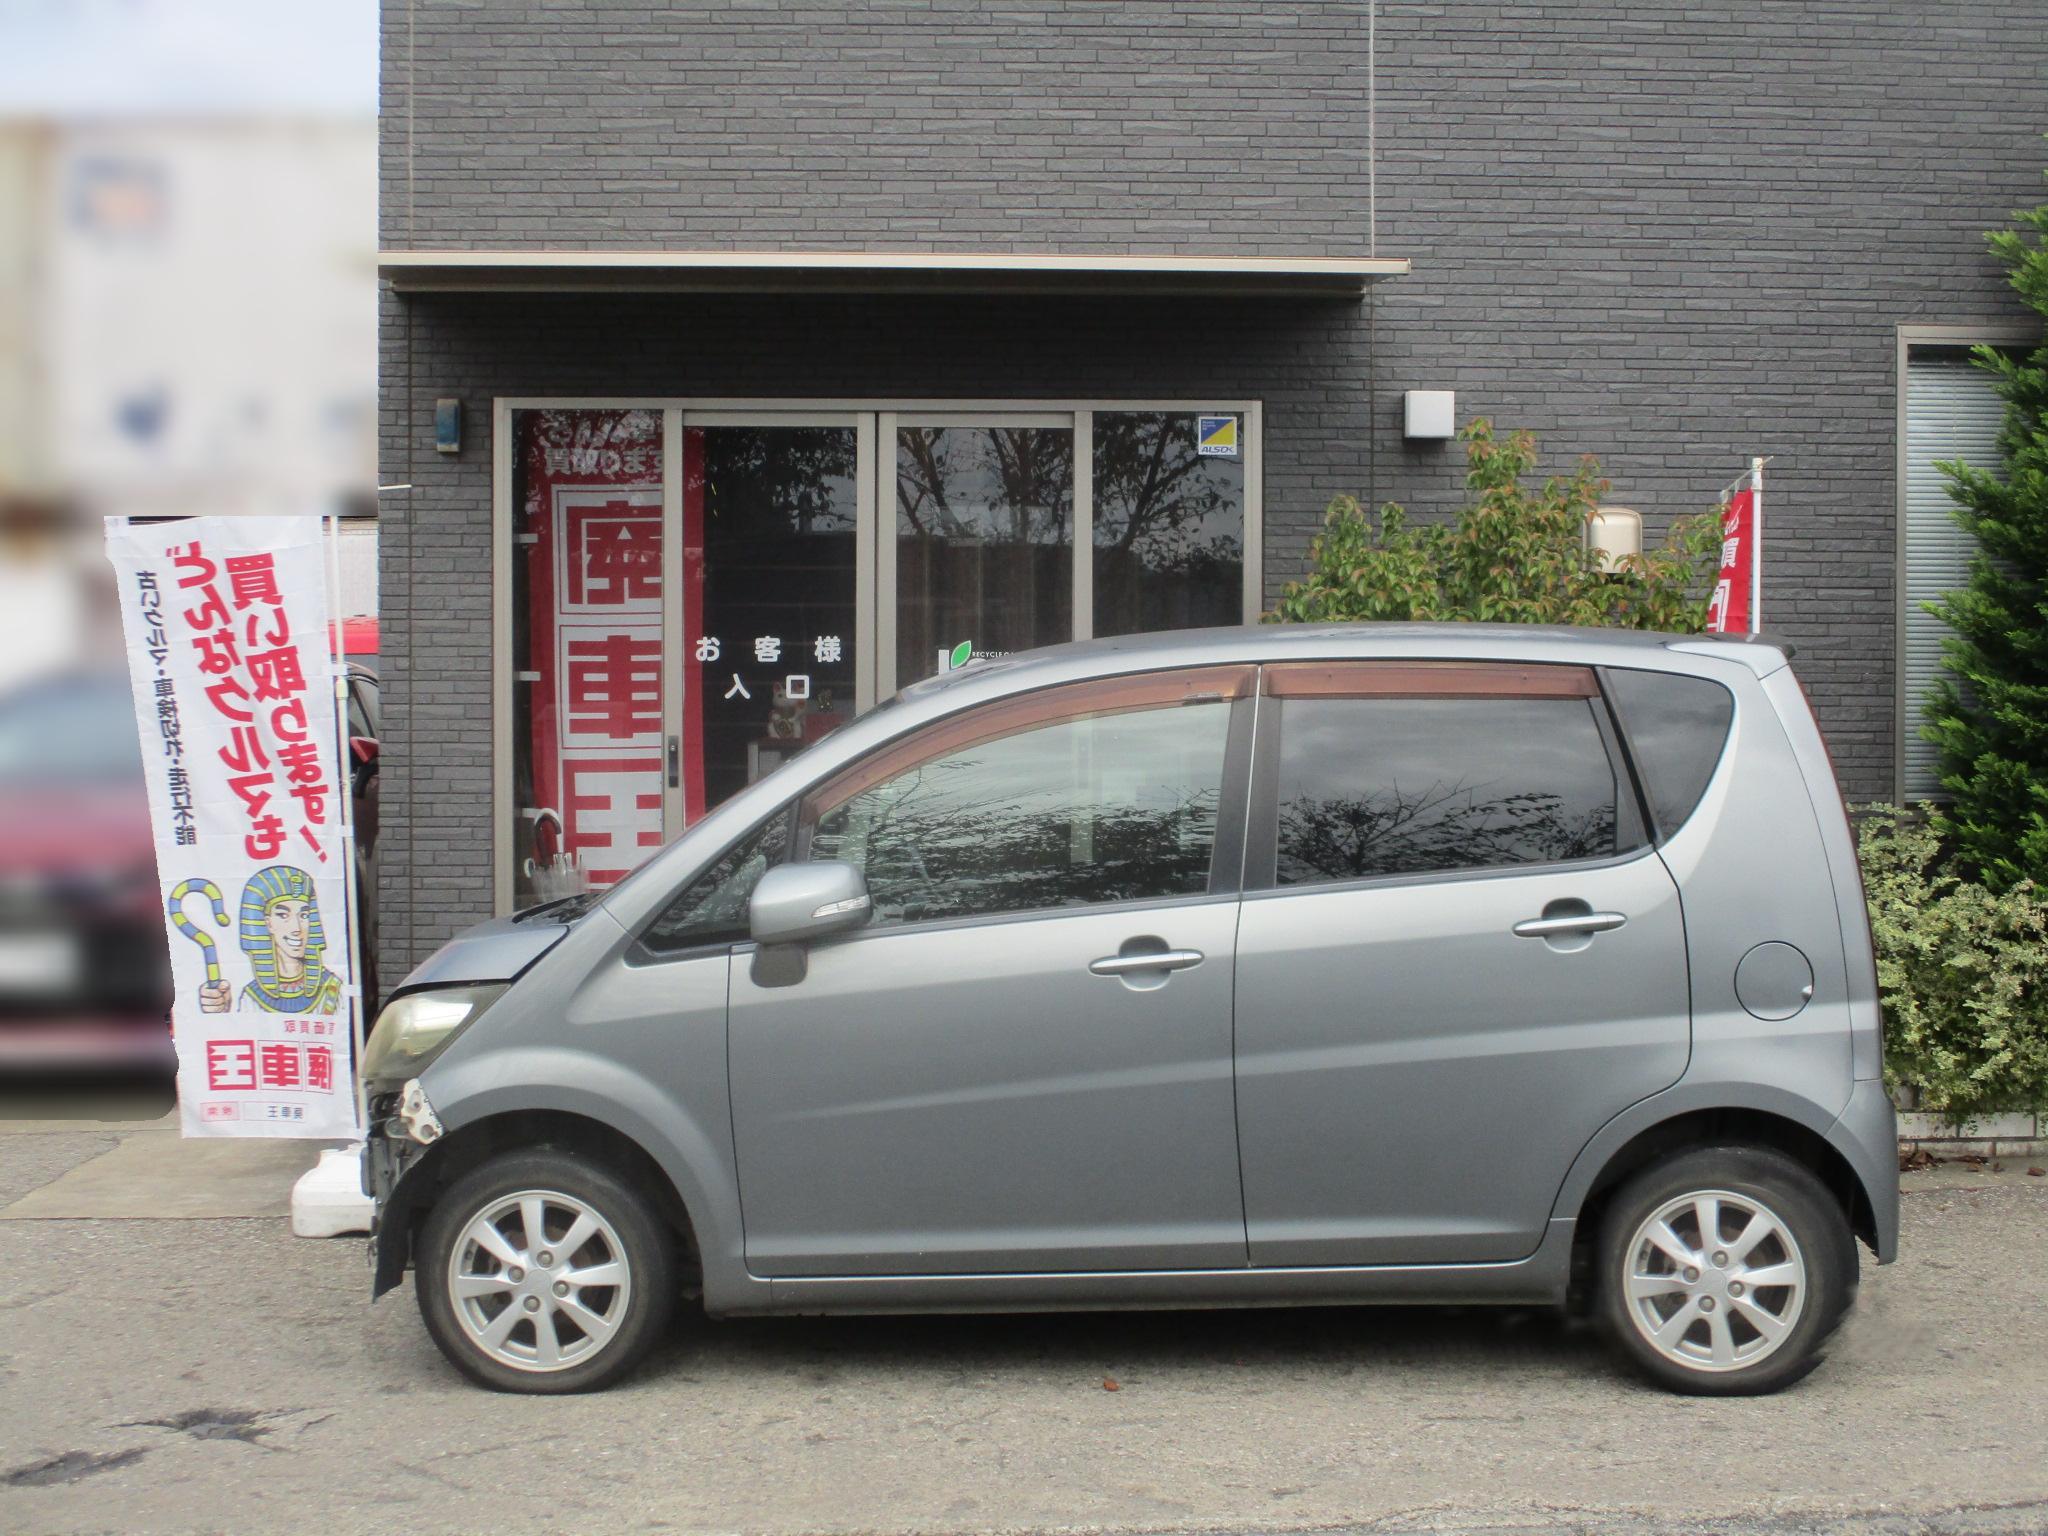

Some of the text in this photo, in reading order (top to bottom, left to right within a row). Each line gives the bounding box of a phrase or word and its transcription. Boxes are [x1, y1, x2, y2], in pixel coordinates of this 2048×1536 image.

[1201, 446, 1233, 454] ALSOK
[695, 635, 841, 663] お客様
[724, 673, 810, 700] 入口
